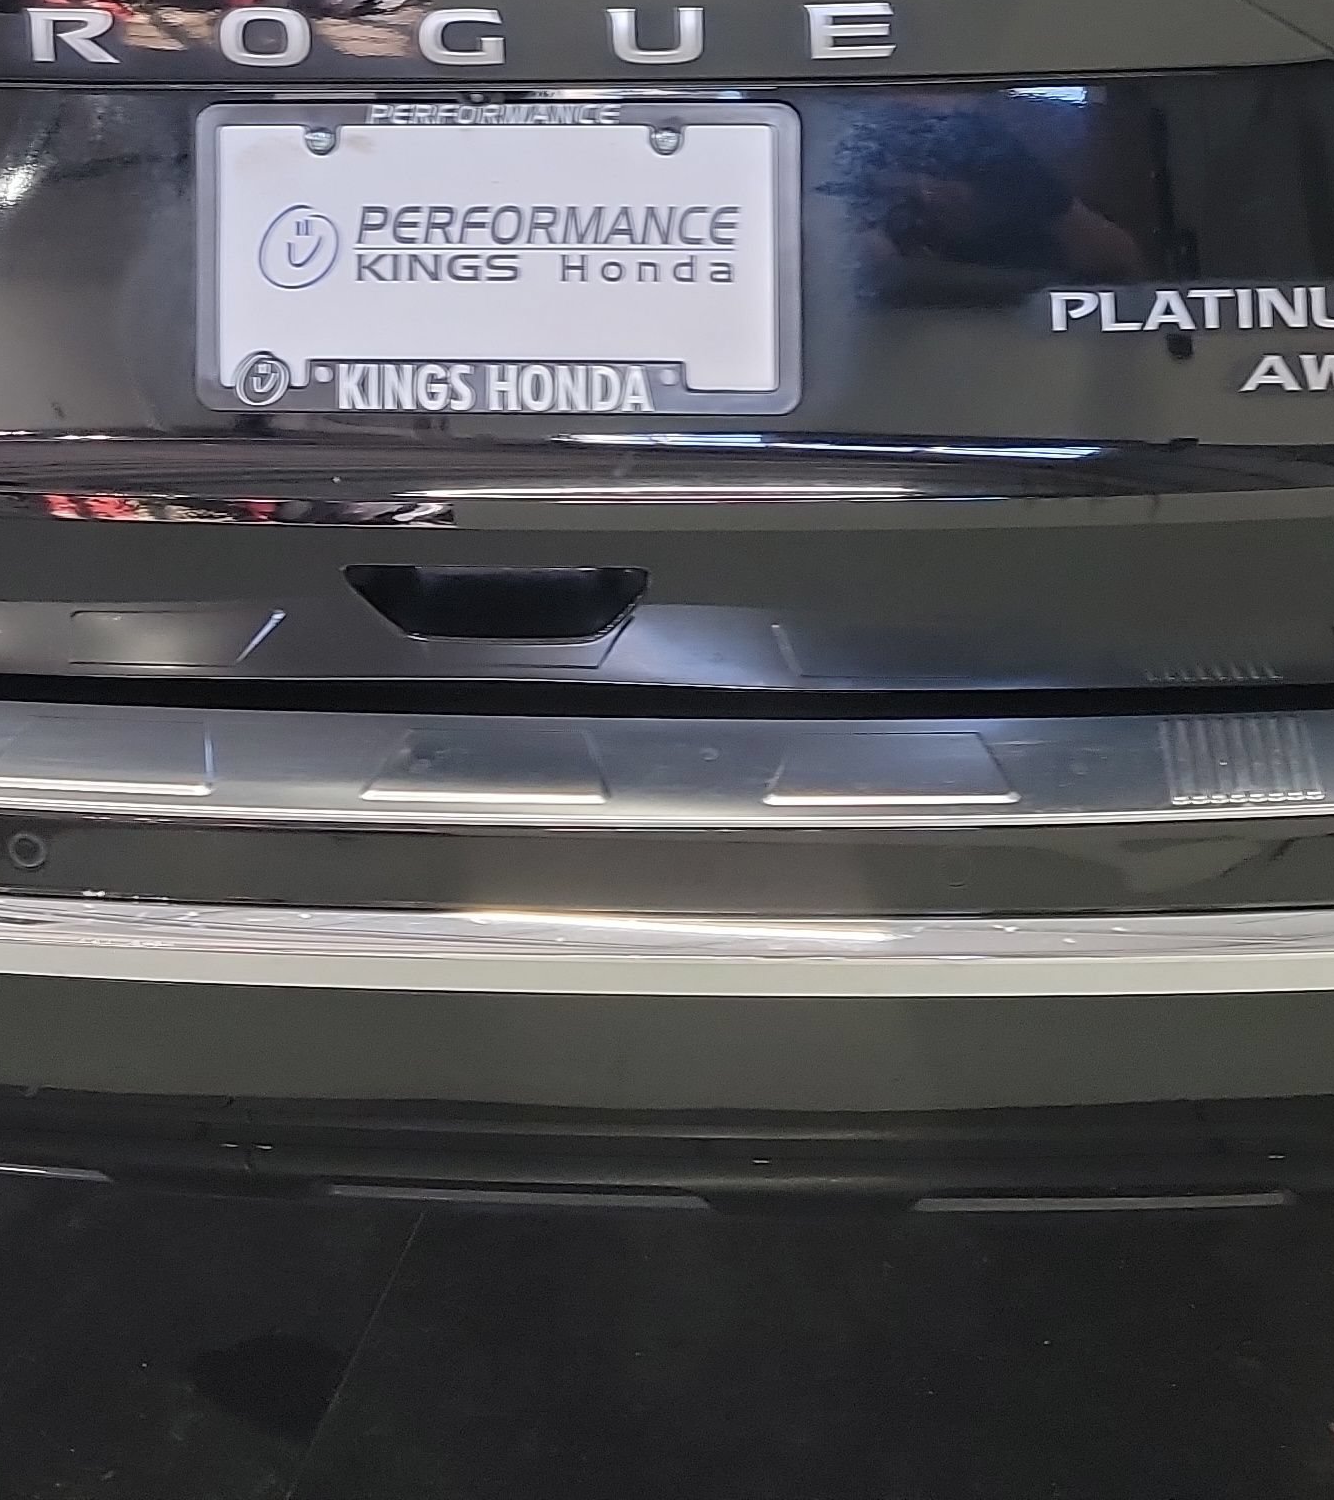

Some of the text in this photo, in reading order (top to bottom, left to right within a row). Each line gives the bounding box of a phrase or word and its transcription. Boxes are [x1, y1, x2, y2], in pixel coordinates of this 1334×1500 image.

[27, 2, 897, 67] ROGUE
[366, 104, 622, 124] PERFORMANCE
[355, 205, 741, 246] PERFORMANCE
[355, 254, 735, 283] KINGS Honda
[338, 364, 655, 412] KINGS HONDA
